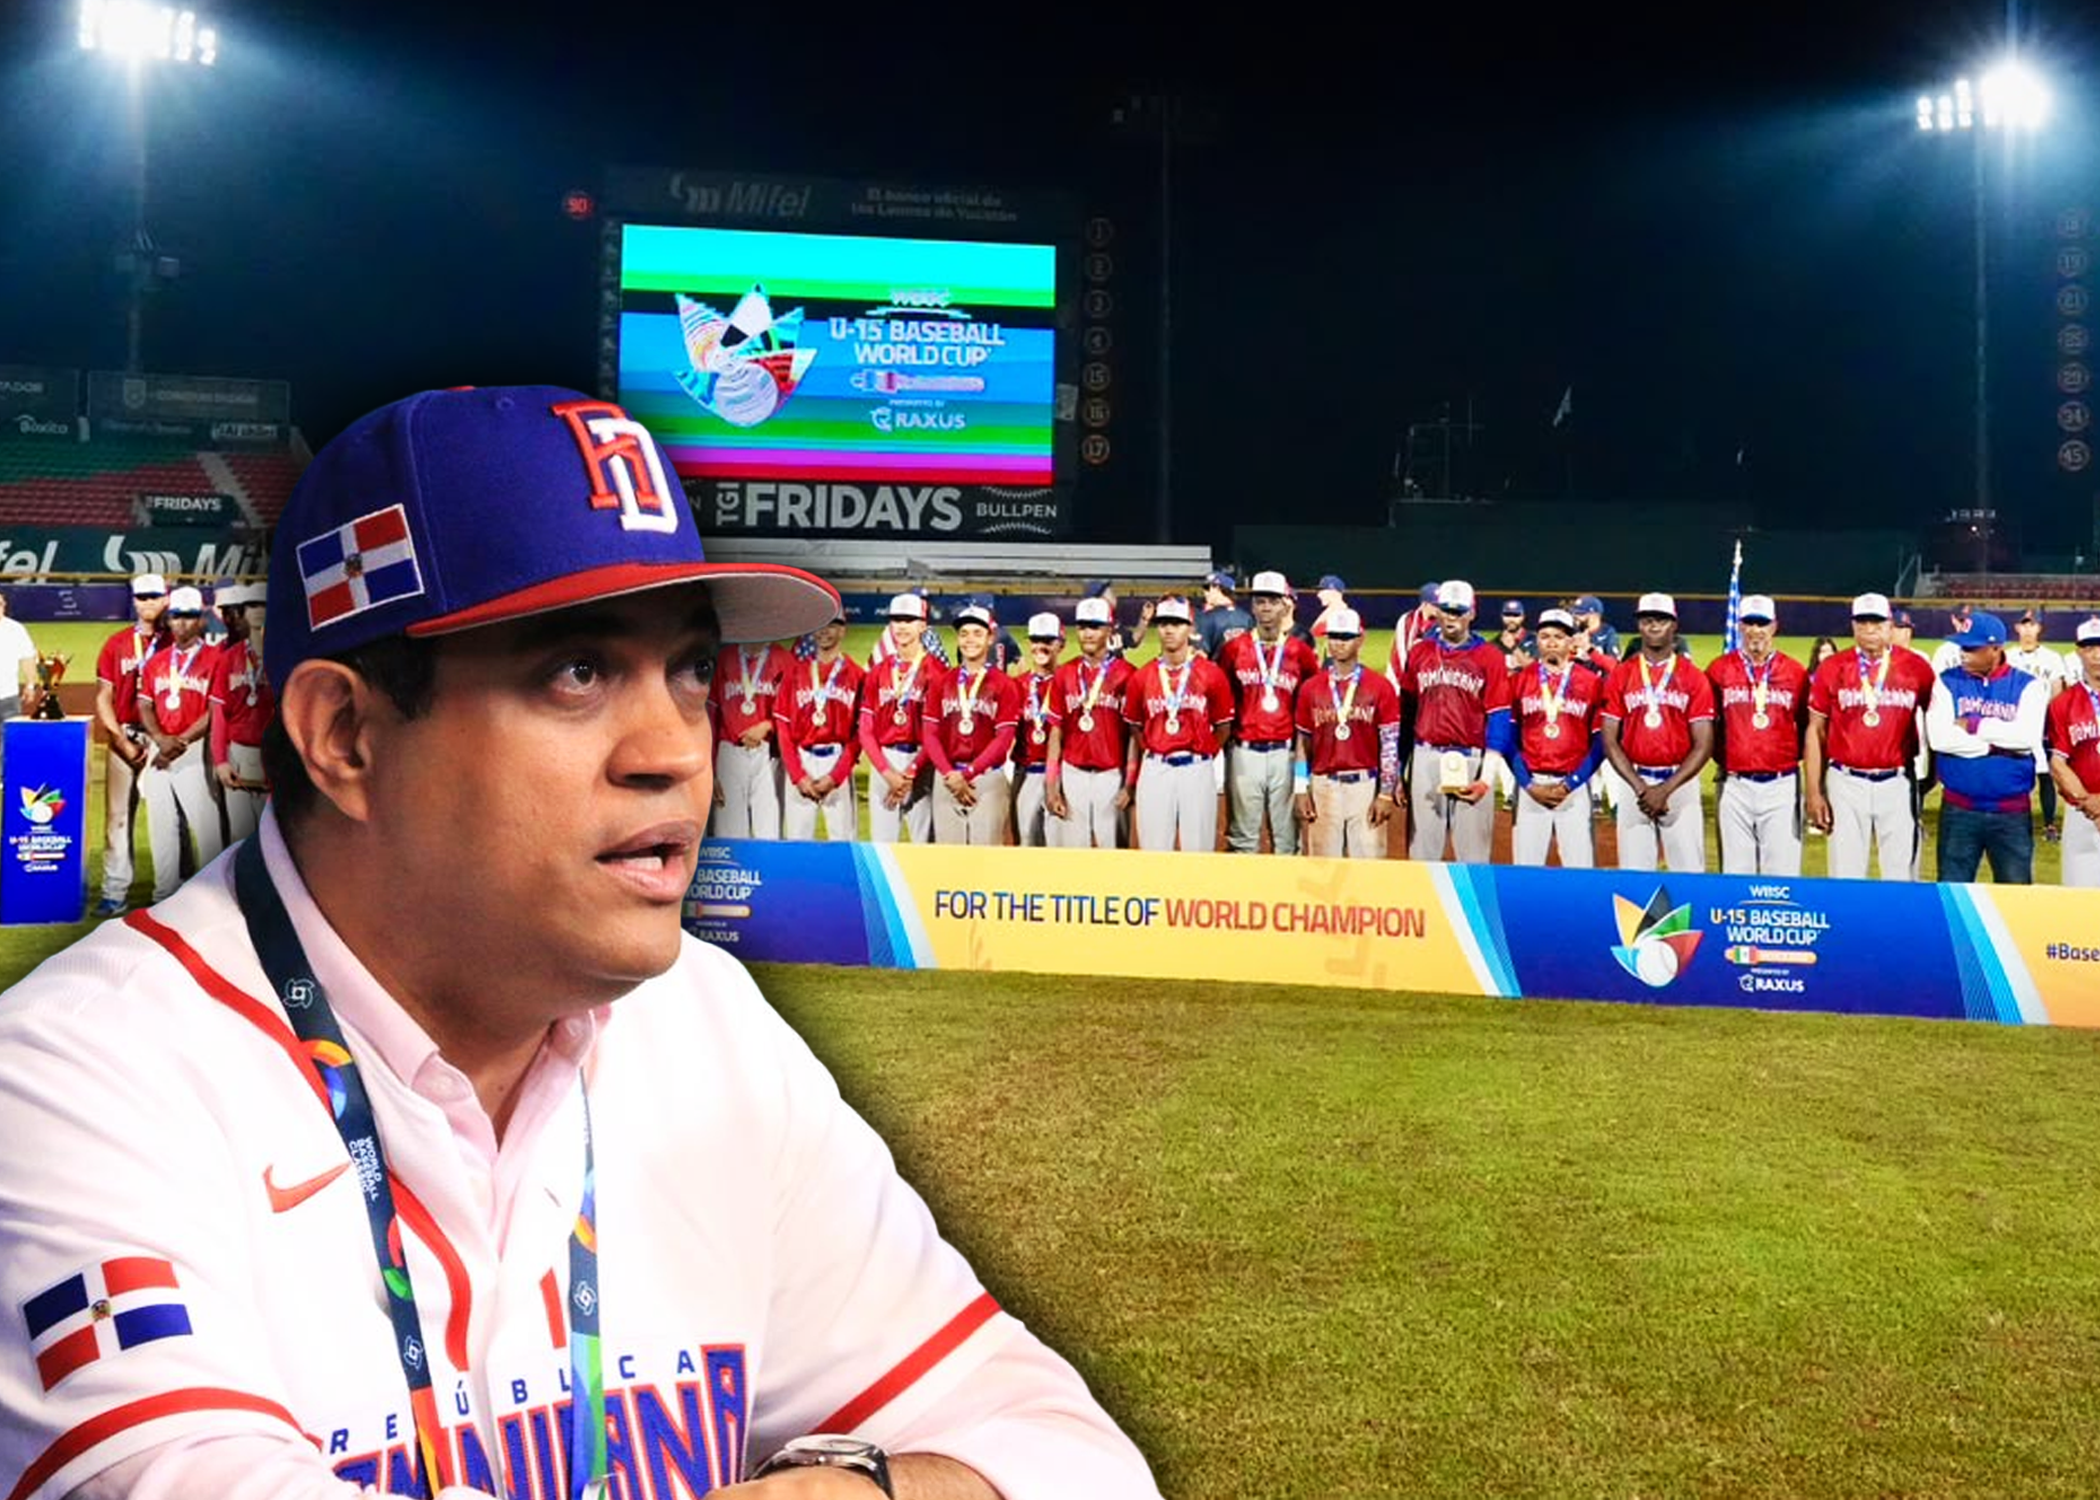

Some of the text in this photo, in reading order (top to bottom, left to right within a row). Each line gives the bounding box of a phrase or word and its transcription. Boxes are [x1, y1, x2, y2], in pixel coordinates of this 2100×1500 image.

[828, 316, 1006, 346] U-15 BASEBALL
[854, 341, 988, 367] WORLD CUP
[895, 412, 966, 429] RAXUS
[153, 496, 223, 512] FRIDAYS
[716, 482, 963, 532] TGI FRIDAYS
[976, 502, 1058, 519] BULLPEN
[697, 868, 763, 886] BASEBALL
[724, 885, 752, 900] CUP
[934, 889, 1426, 939] FOR THE TITLE OF WORLD CHAMPION
[1710, 906, 1831, 929] U-15 BASEBALL
[1726, 925, 1818, 946] WORLD CUP
[1755, 978, 1805, 993] RAXUS
[365, 1135, 383, 1182] WORLD
